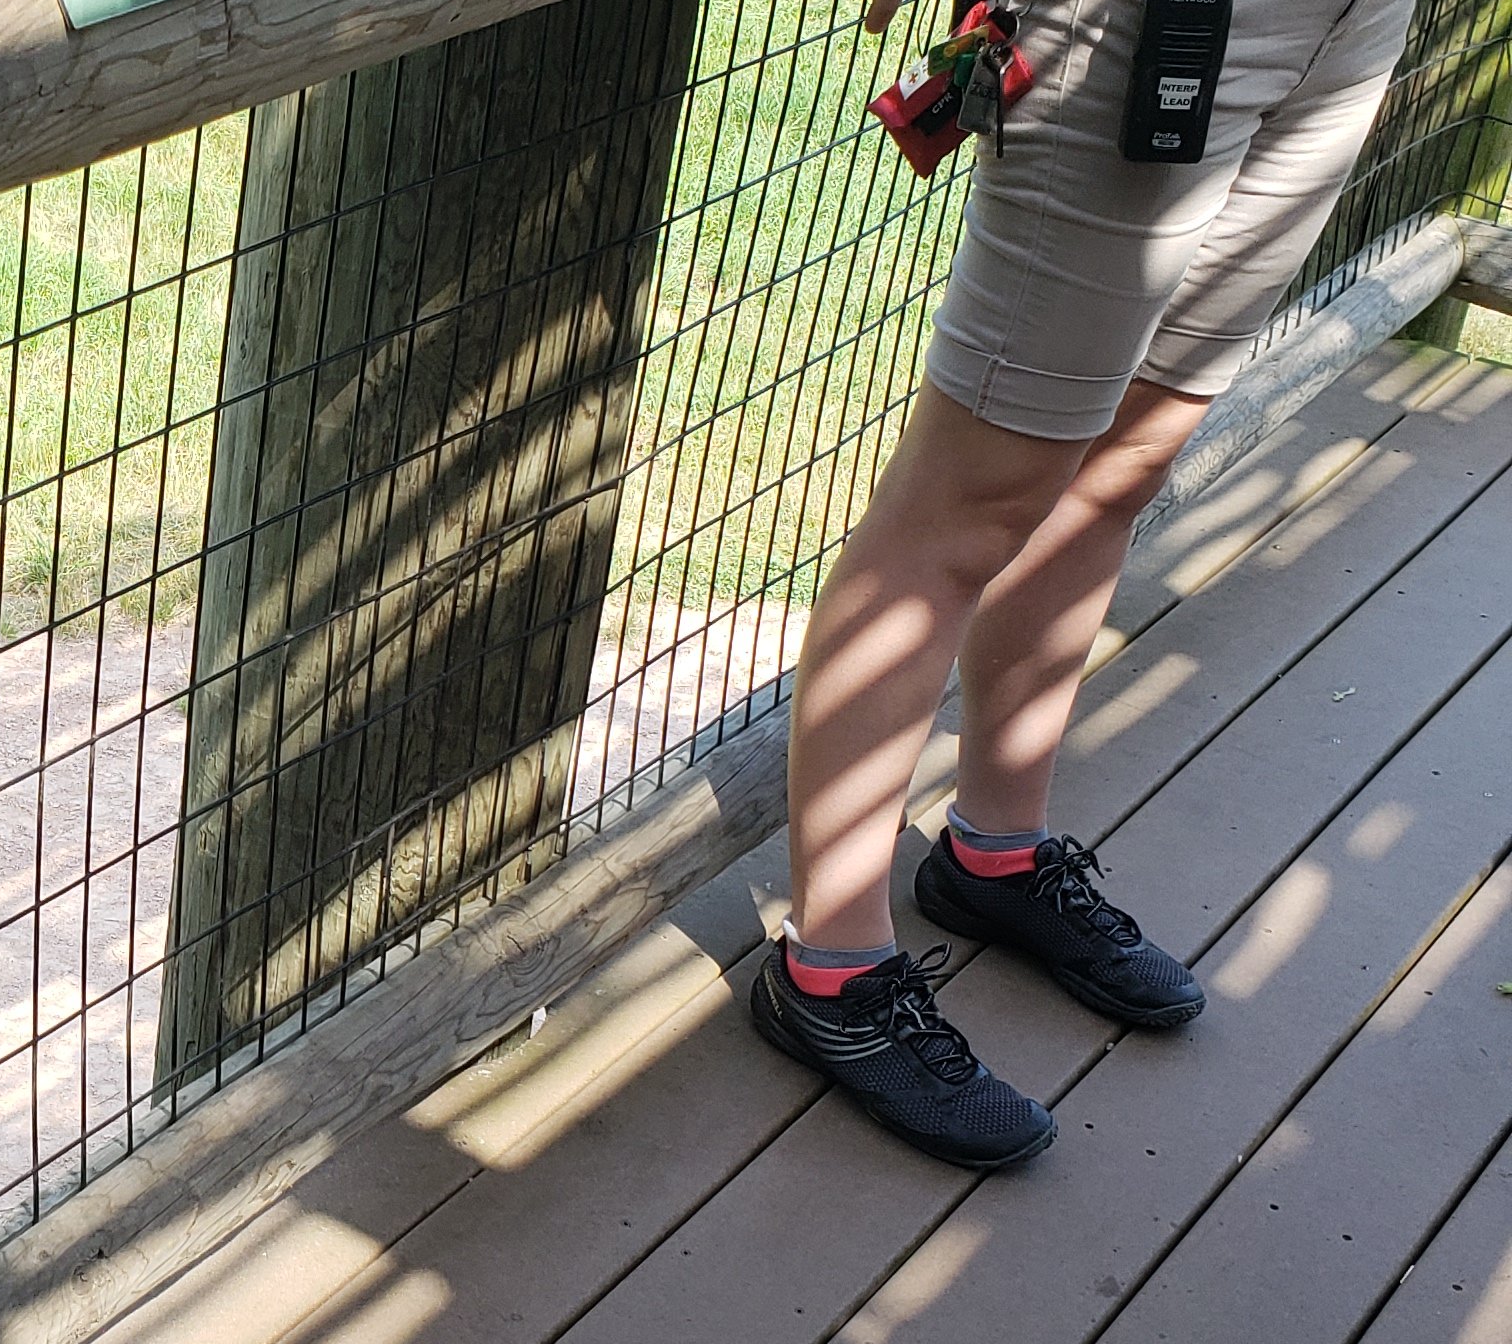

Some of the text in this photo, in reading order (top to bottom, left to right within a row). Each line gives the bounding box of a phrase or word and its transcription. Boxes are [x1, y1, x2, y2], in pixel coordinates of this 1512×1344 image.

[1160, 83, 1198, 93] INTERP
[932, 92, 952, 114] CPR
[1163, 97, 1190, 106] LEAD
